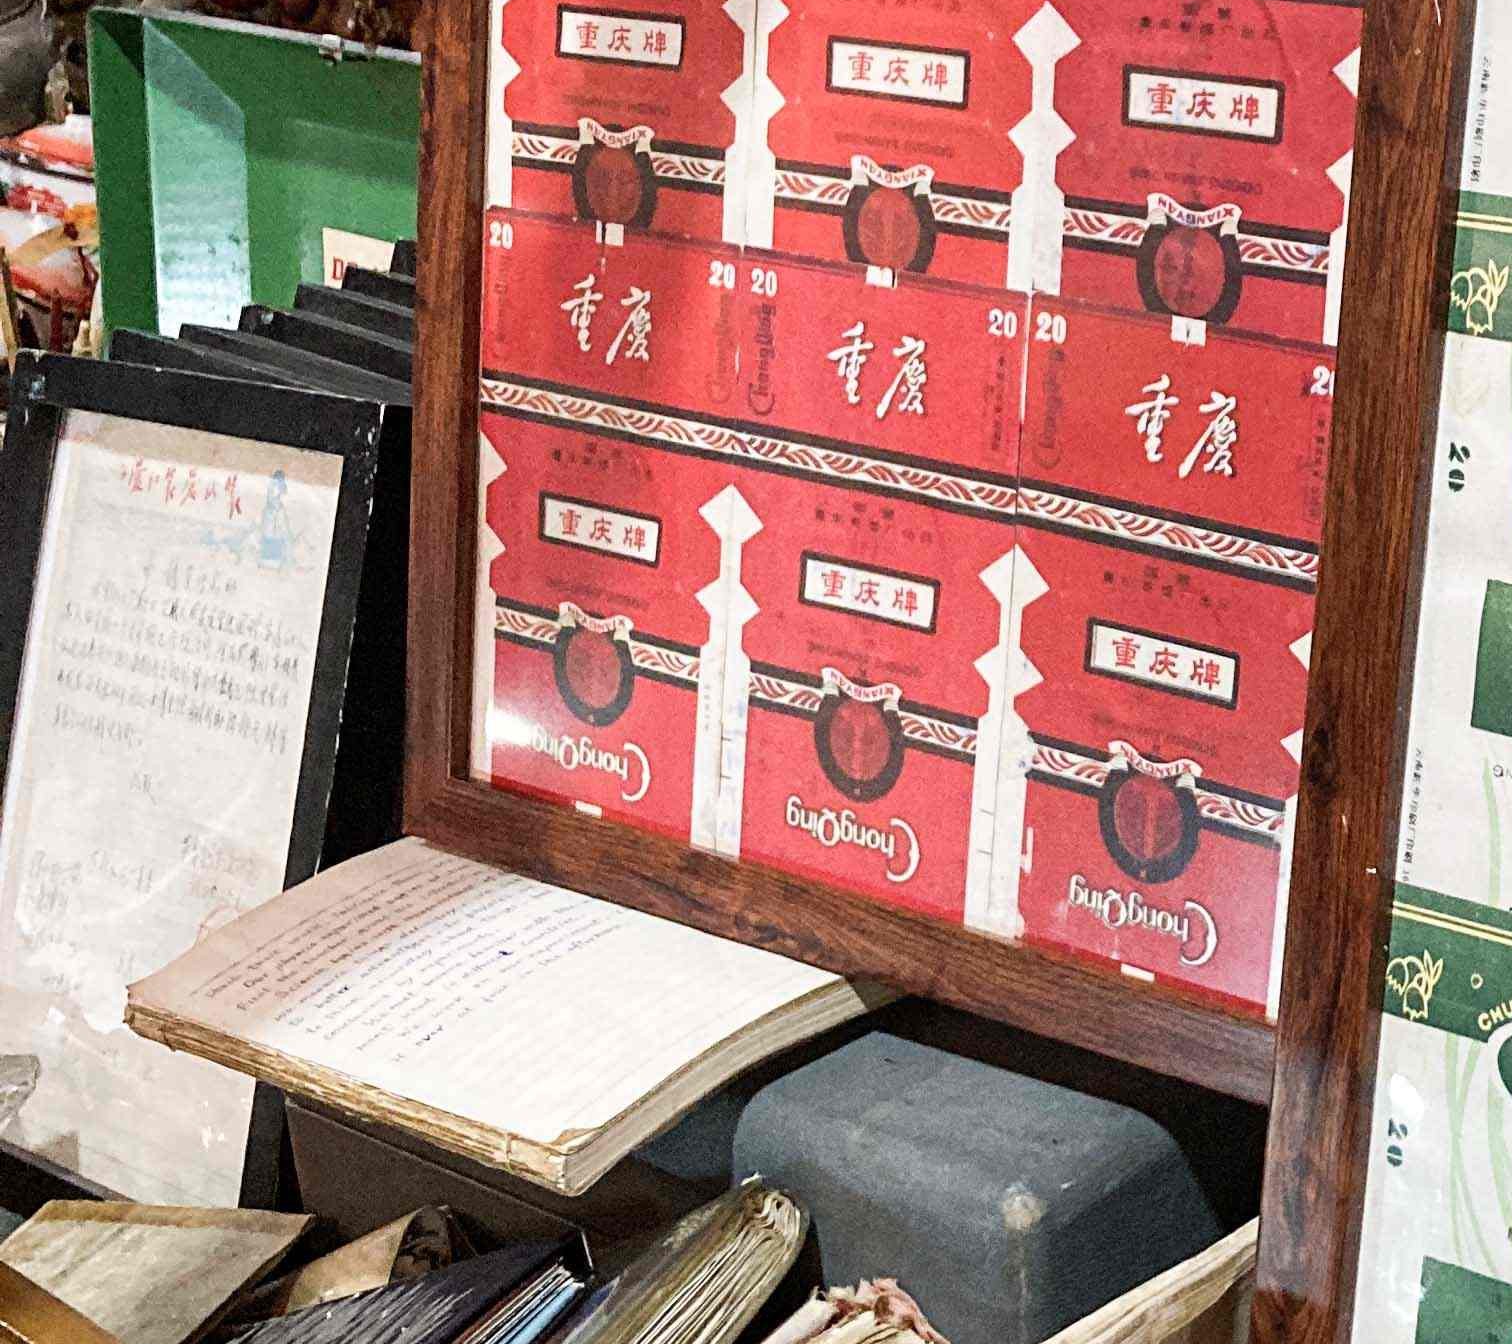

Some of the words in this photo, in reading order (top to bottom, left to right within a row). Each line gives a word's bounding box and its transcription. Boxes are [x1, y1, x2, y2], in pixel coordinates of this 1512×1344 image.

[576, 21, 668, 58] 重庆牌
[848, 51, 953, 91] 重庆牌
[1147, 83, 1259, 126] 重庆牌
[489, 222, 513, 249] 20
[709, 262, 736, 288] 20
[1035, 314, 1067, 343] 20
[559, 508, 646, 552] 重庆牌
[820, 570, 918, 617] 重庆牌
[1113, 635, 1220, 692] 重庆牌
[786, 795, 919, 882] ChongQing
[1068, 874, 1218, 966] ChongQing
